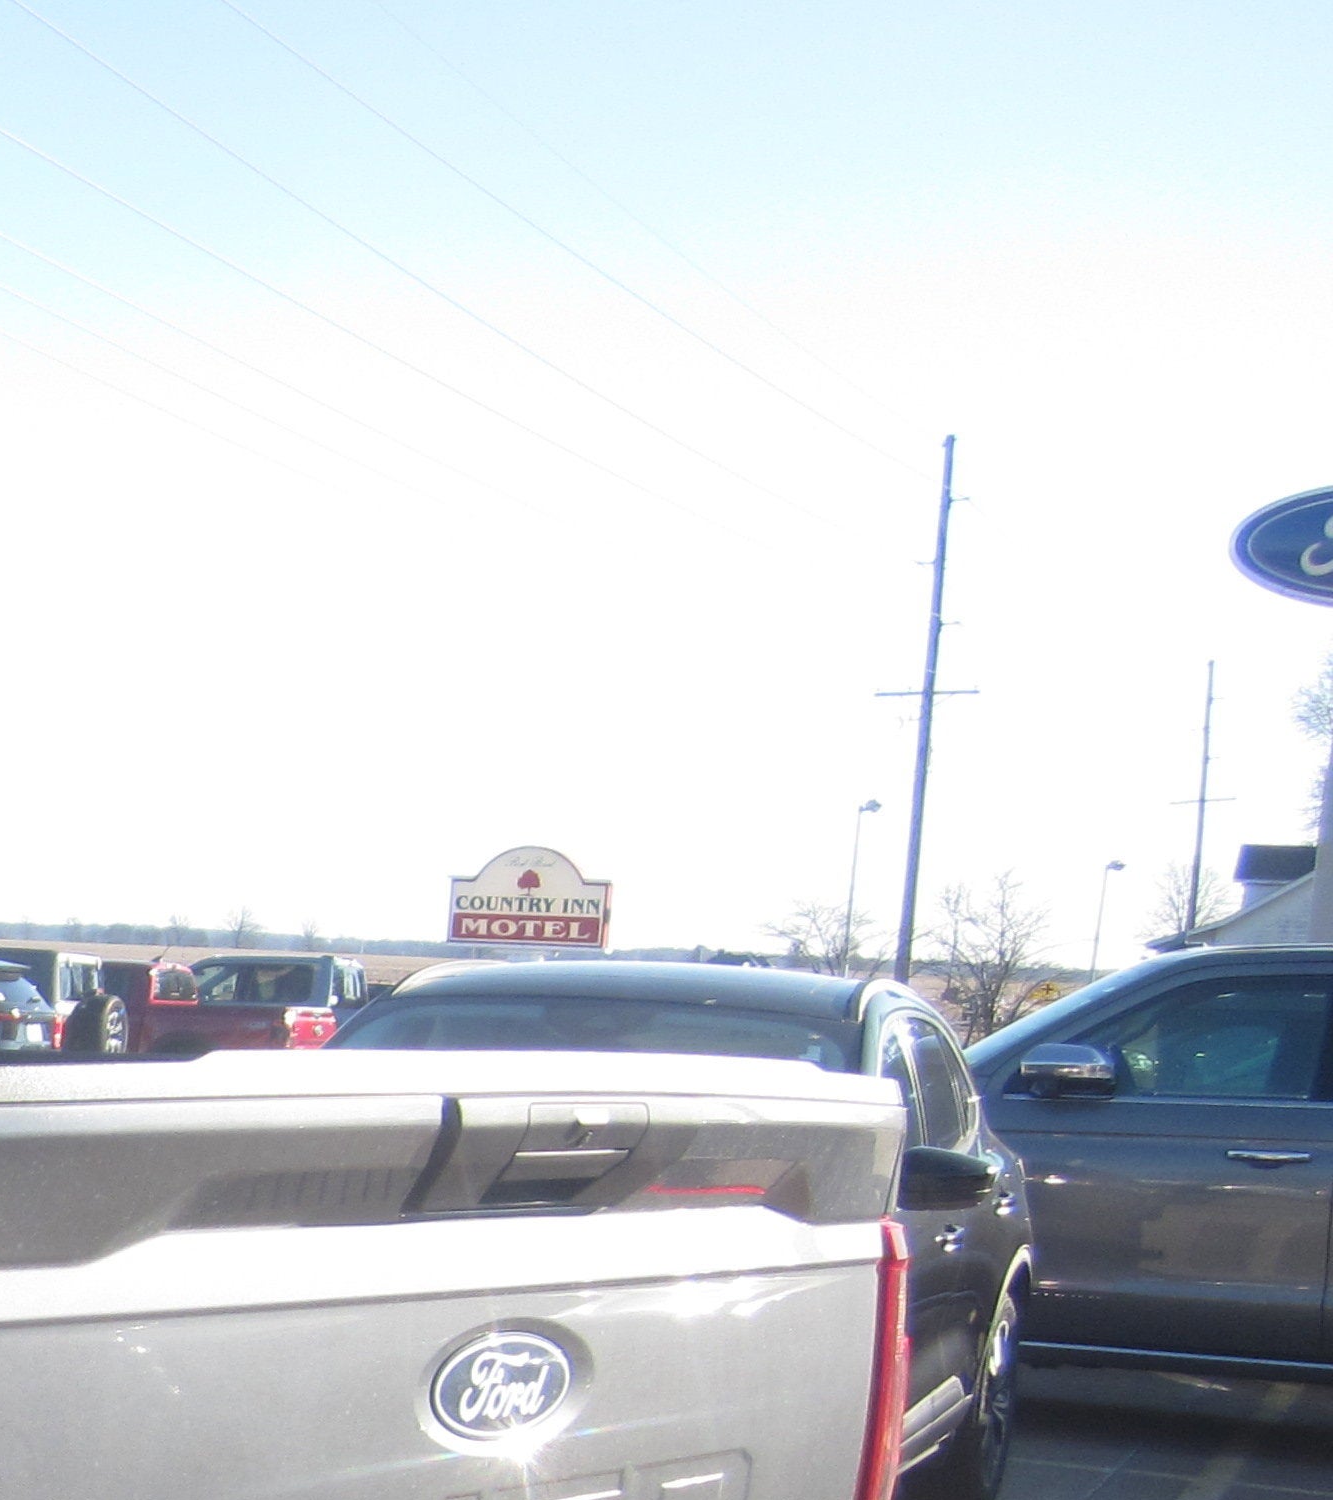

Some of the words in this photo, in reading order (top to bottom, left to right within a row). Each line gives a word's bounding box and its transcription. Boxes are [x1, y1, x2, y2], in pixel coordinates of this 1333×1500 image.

[455, 895, 557, 913] COUNTRY
[561, 898, 600, 915] INN
[460, 918, 591, 940] MOTEL
[459, 1350, 563, 1423] Ford
